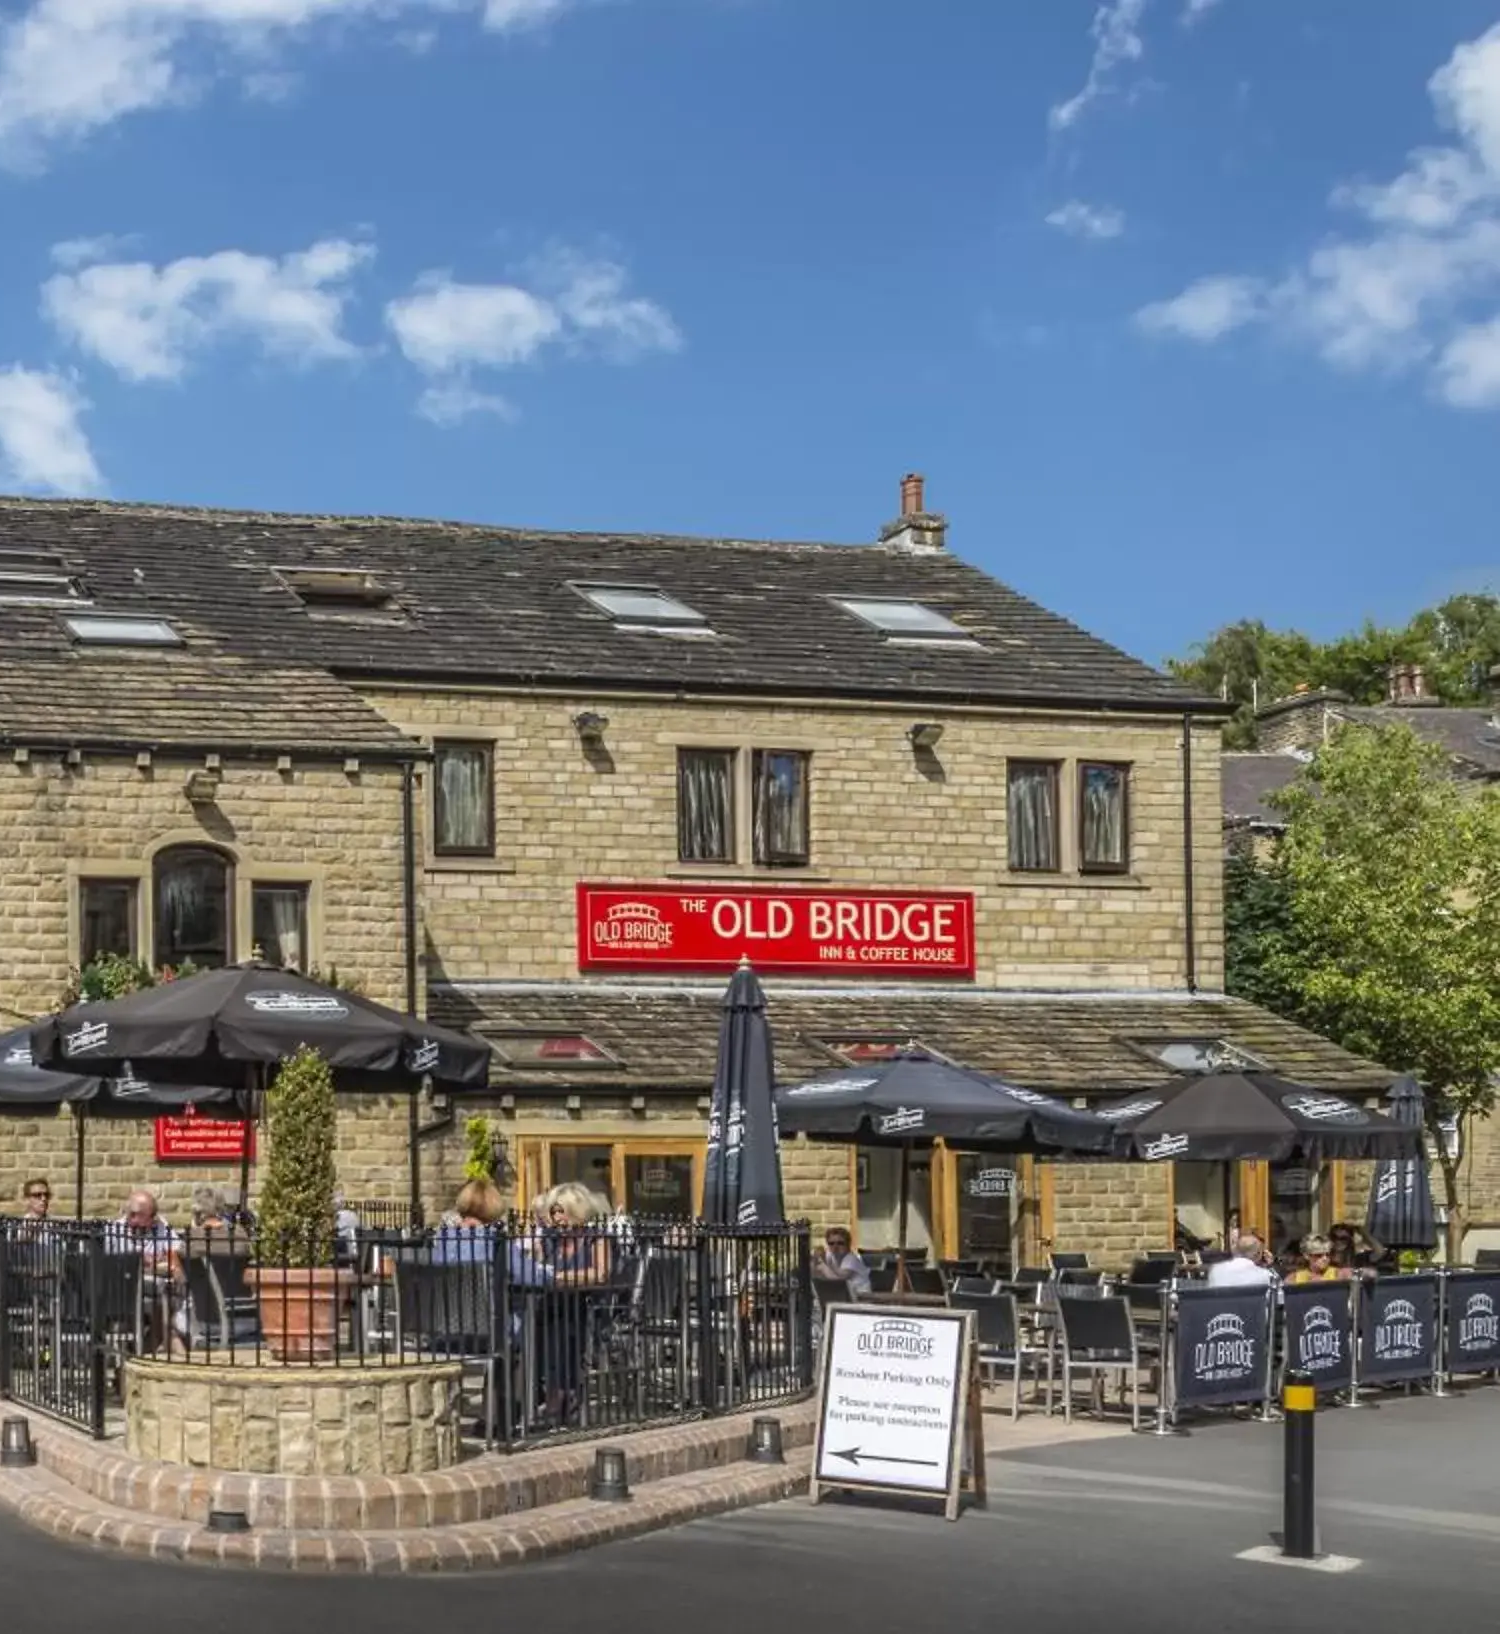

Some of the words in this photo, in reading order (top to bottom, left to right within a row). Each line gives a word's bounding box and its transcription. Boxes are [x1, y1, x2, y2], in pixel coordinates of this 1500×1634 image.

[680, 898, 707, 913] THE
[711, 899, 794, 940] OLD
[809, 901, 957, 943] BRIDGE
[594, 920, 621, 943] OLD
[624, 921, 674, 945] BRIDGE
[819, 946, 844, 959] INN
[847, 947, 856, 960] &
[859, 946, 910, 961] COFFEE
[913, 948, 956, 963] HOUSE
[857, 1333, 883, 1351] OLD
[887, 1335, 936, 1356] BRIDGE
[1216, 1338, 1256, 1368] BRIDGE
[883, 1371, 923, 1386] Parking
[925, 1375, 951, 1388] Only
[845, 1412, 884, 1426] parking
